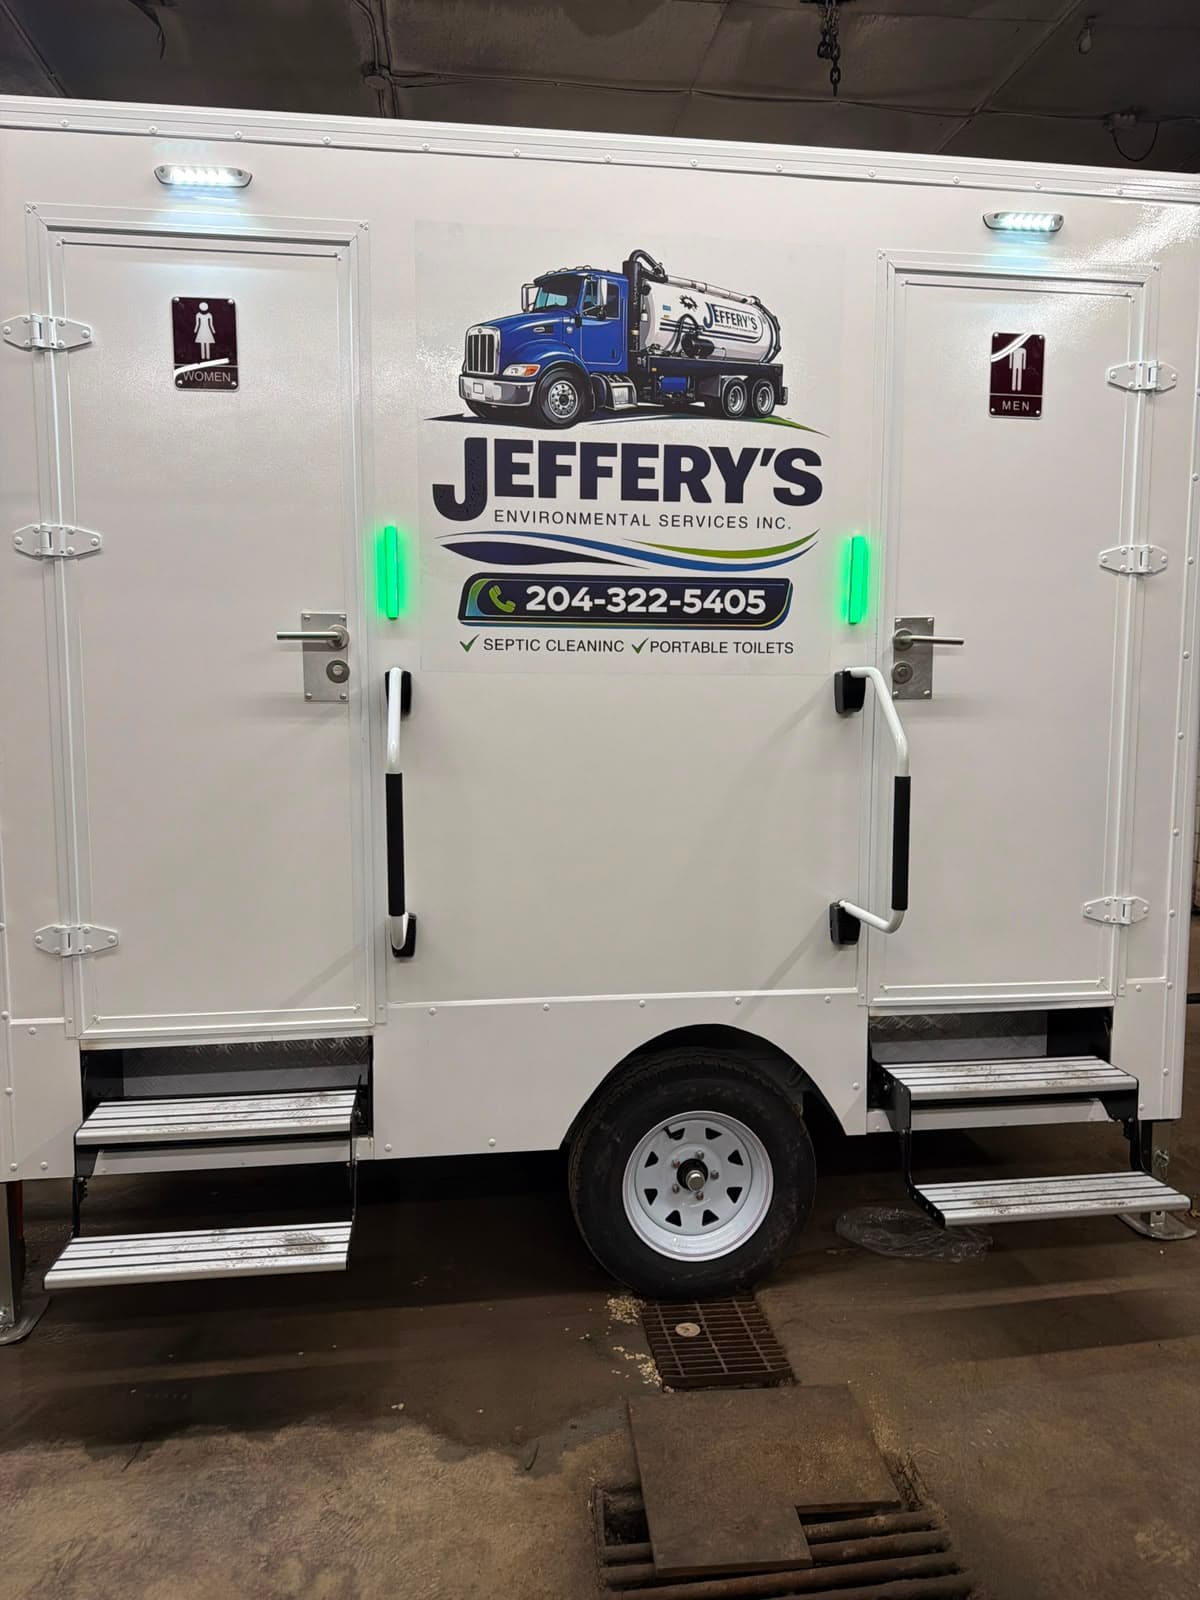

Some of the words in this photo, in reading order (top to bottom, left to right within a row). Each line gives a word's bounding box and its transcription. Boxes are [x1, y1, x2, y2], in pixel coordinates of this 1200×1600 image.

[703, 302, 758, 330] JEFFERY'S
[183, 371, 231, 382] WOMEN
[1002, 400, 1030, 411] MEN
[432, 437, 823, 522] JEFFERY'S
[494, 509, 651, 527] ENVIRONMENTAL
[658, 514, 748, 529] SERVICES
[756, 516, 791, 530] INC.
[525, 585, 766, 615] 204-322-5405
[483, 638, 541, 651] SEPTIC
[650, 640, 728, 654] PORTABLE
[733, 641, 794, 654] TOILETS
